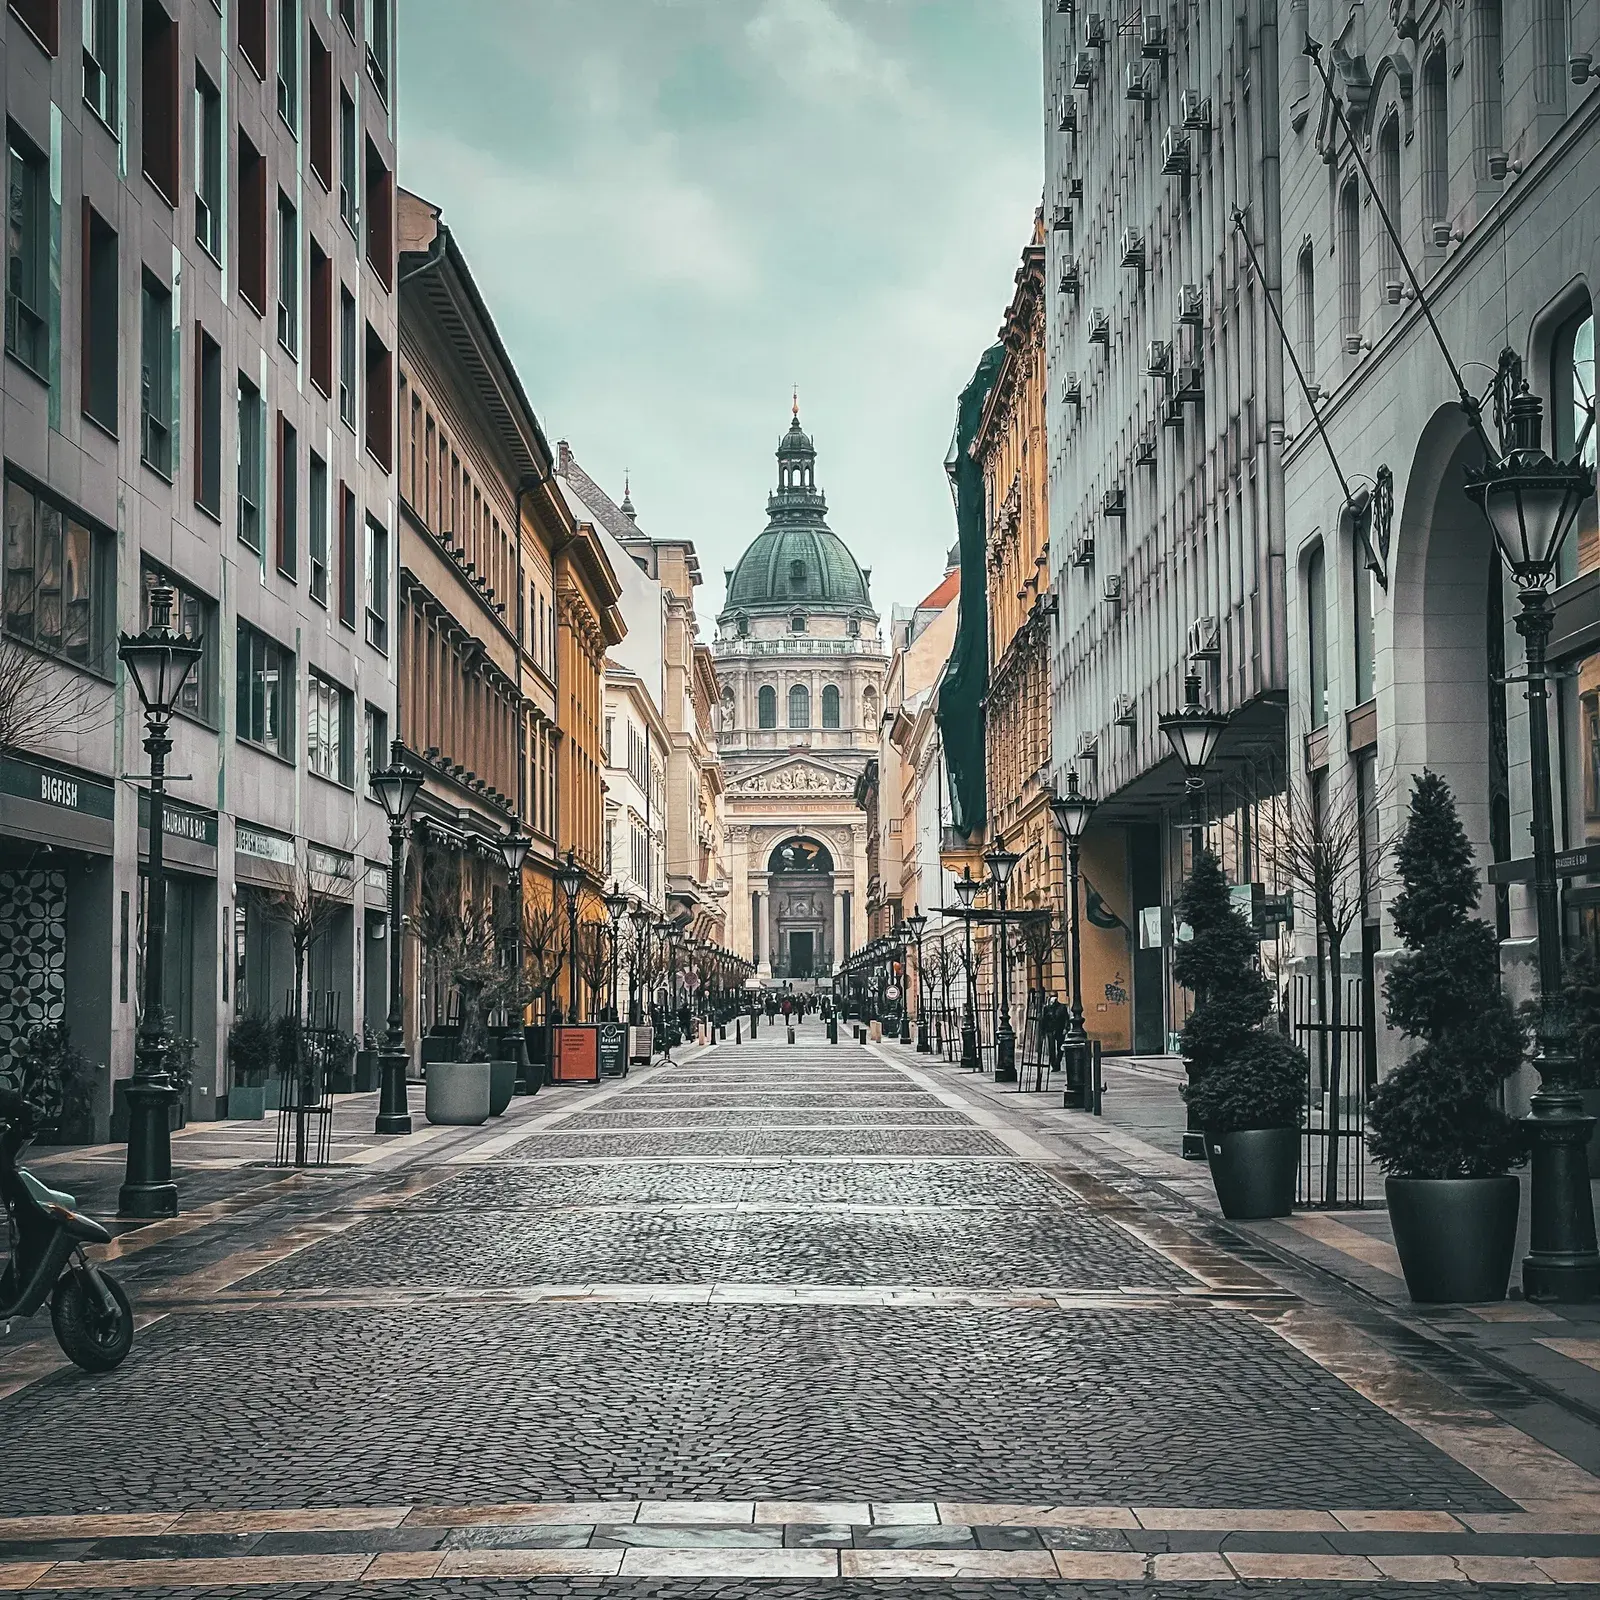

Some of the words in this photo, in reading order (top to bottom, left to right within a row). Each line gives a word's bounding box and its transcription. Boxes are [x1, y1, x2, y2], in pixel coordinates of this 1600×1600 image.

[41, 774, 77, 807] BIGFISH
[190, 817, 194, 838] &
[195, 819, 206, 841] BAR
